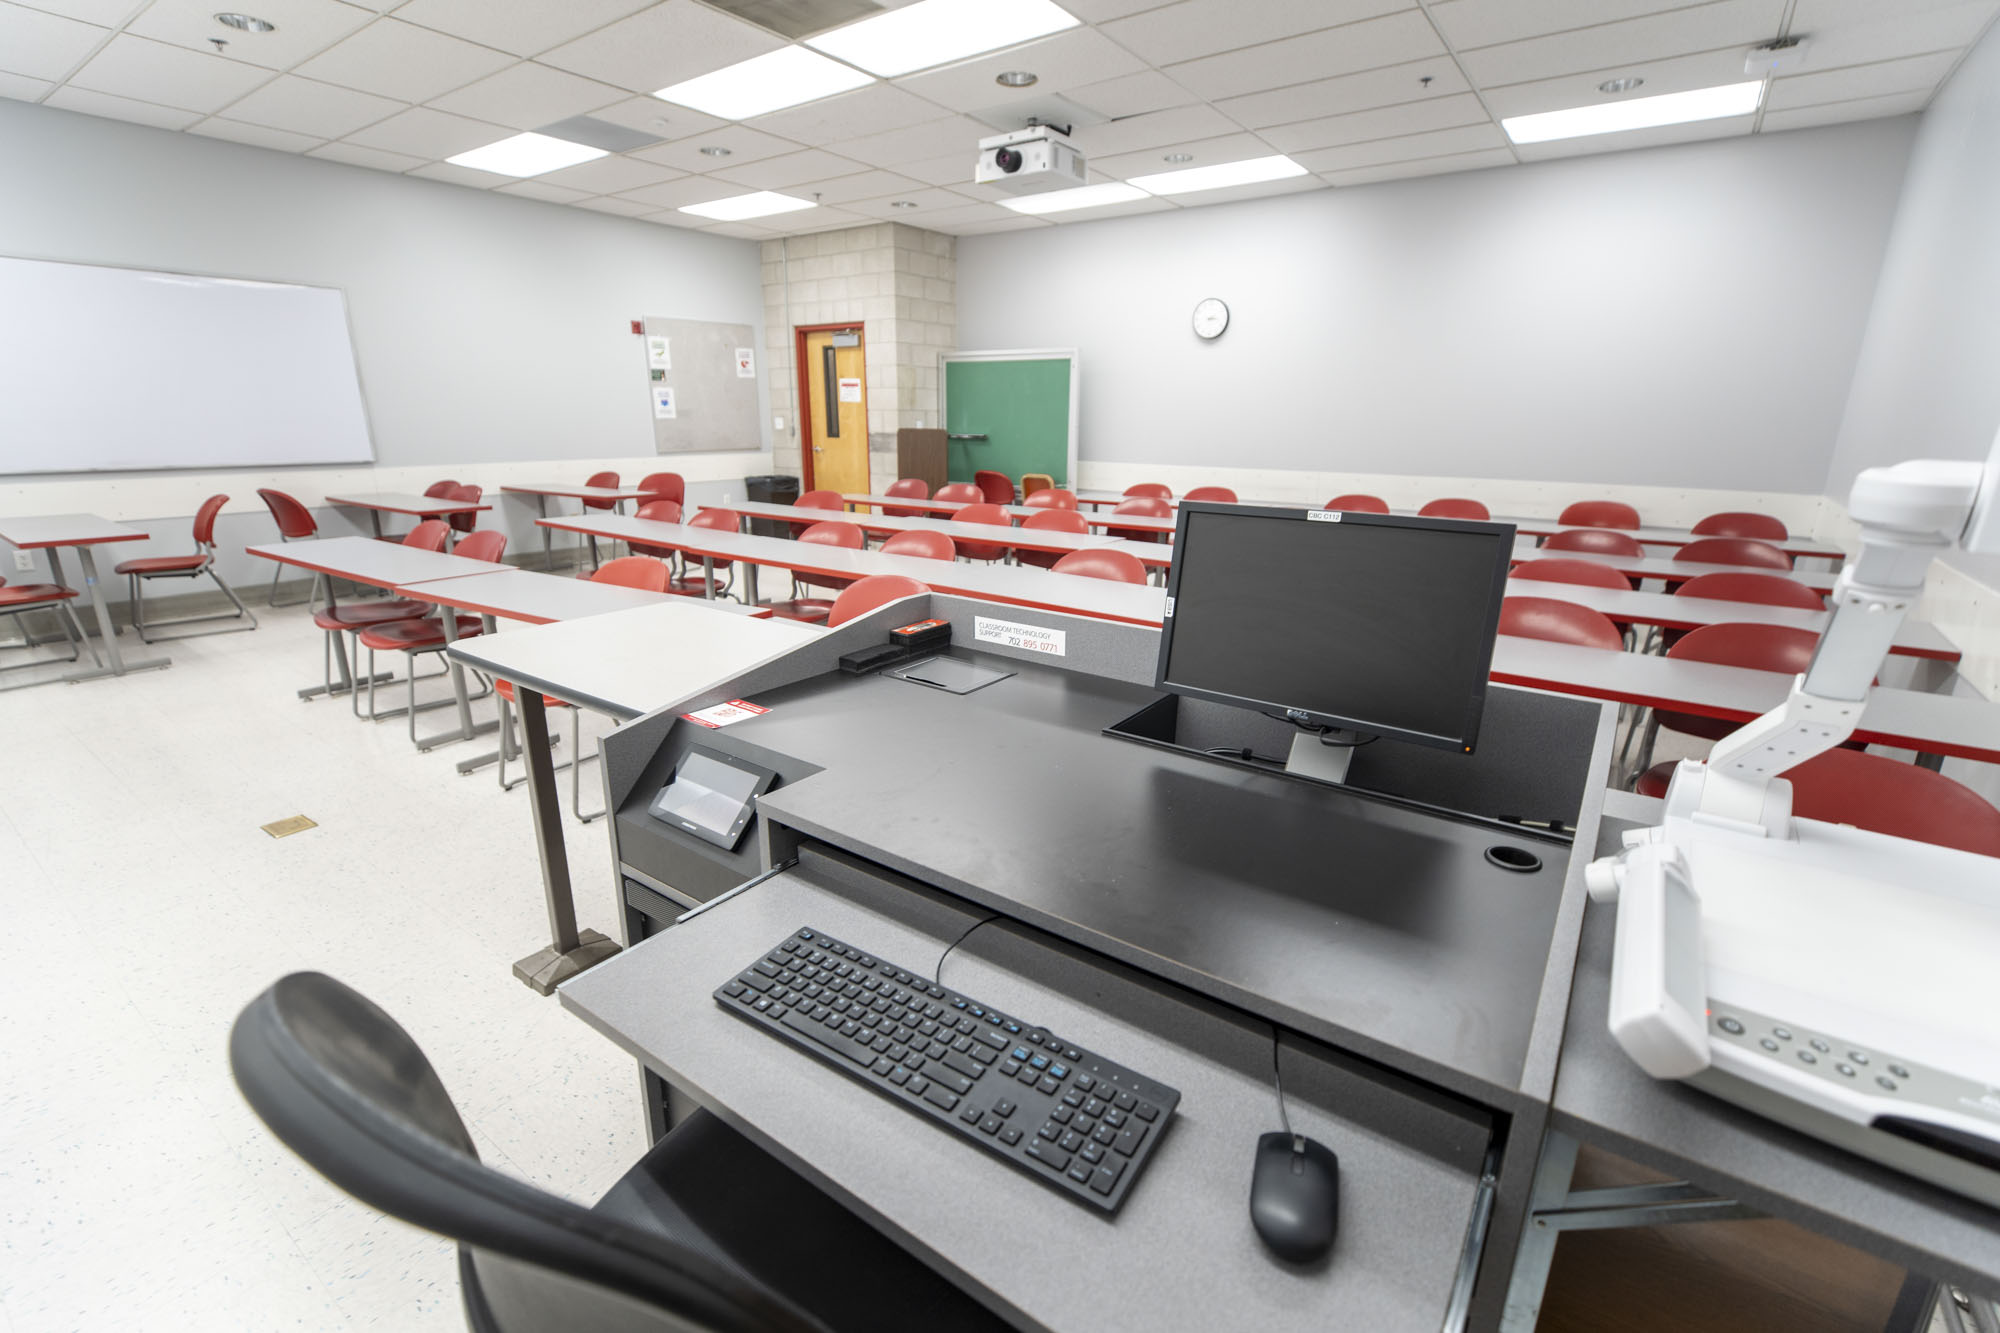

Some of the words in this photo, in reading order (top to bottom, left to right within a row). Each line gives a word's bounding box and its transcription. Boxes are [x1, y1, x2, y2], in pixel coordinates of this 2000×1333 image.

[979, 623, 1011, 633] CLASSROOM
[1012, 628, 1051, 640] TECHNOLOGY
[979, 629, 1001, 638] SUPPORT
[1008, 637, 1021, 646] 702
[1023, 640, 1038, 649] 895
[1040, 642, 1058, 652] 0771
